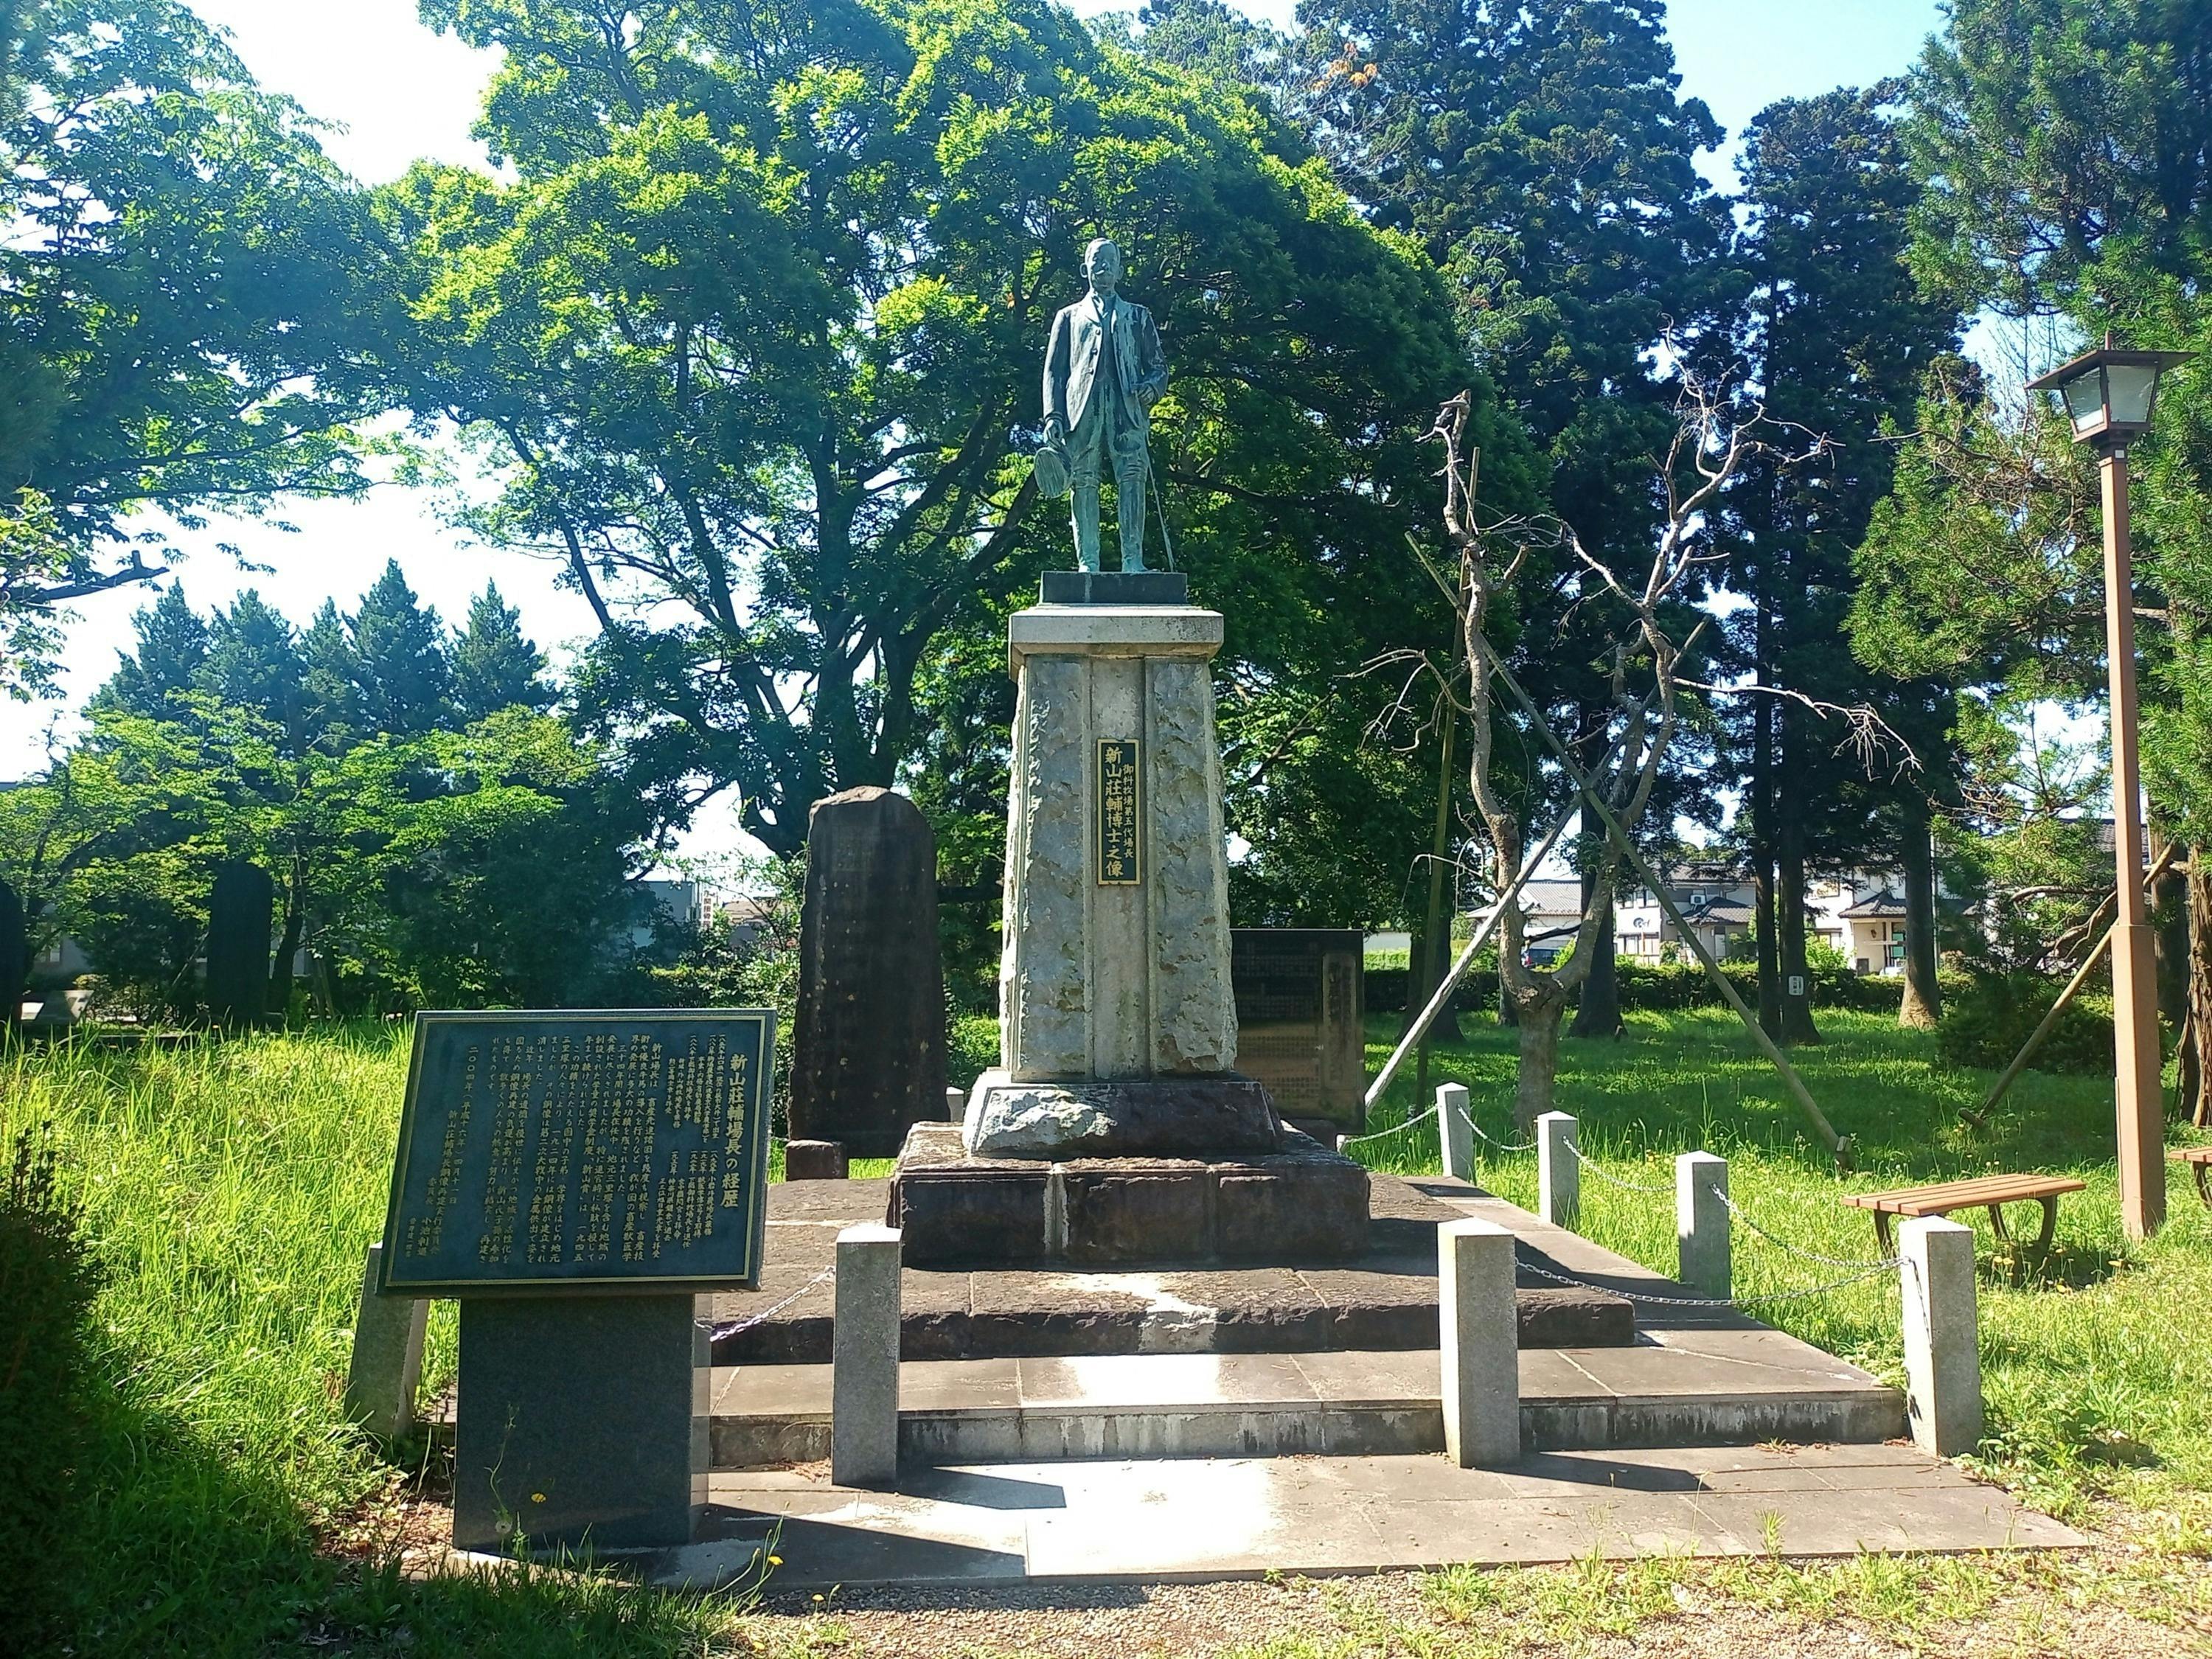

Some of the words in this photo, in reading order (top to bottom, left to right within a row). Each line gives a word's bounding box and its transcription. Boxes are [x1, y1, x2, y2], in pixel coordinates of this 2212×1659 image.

[1123, 764, 1134, 858] 御料牧場第五代場長
